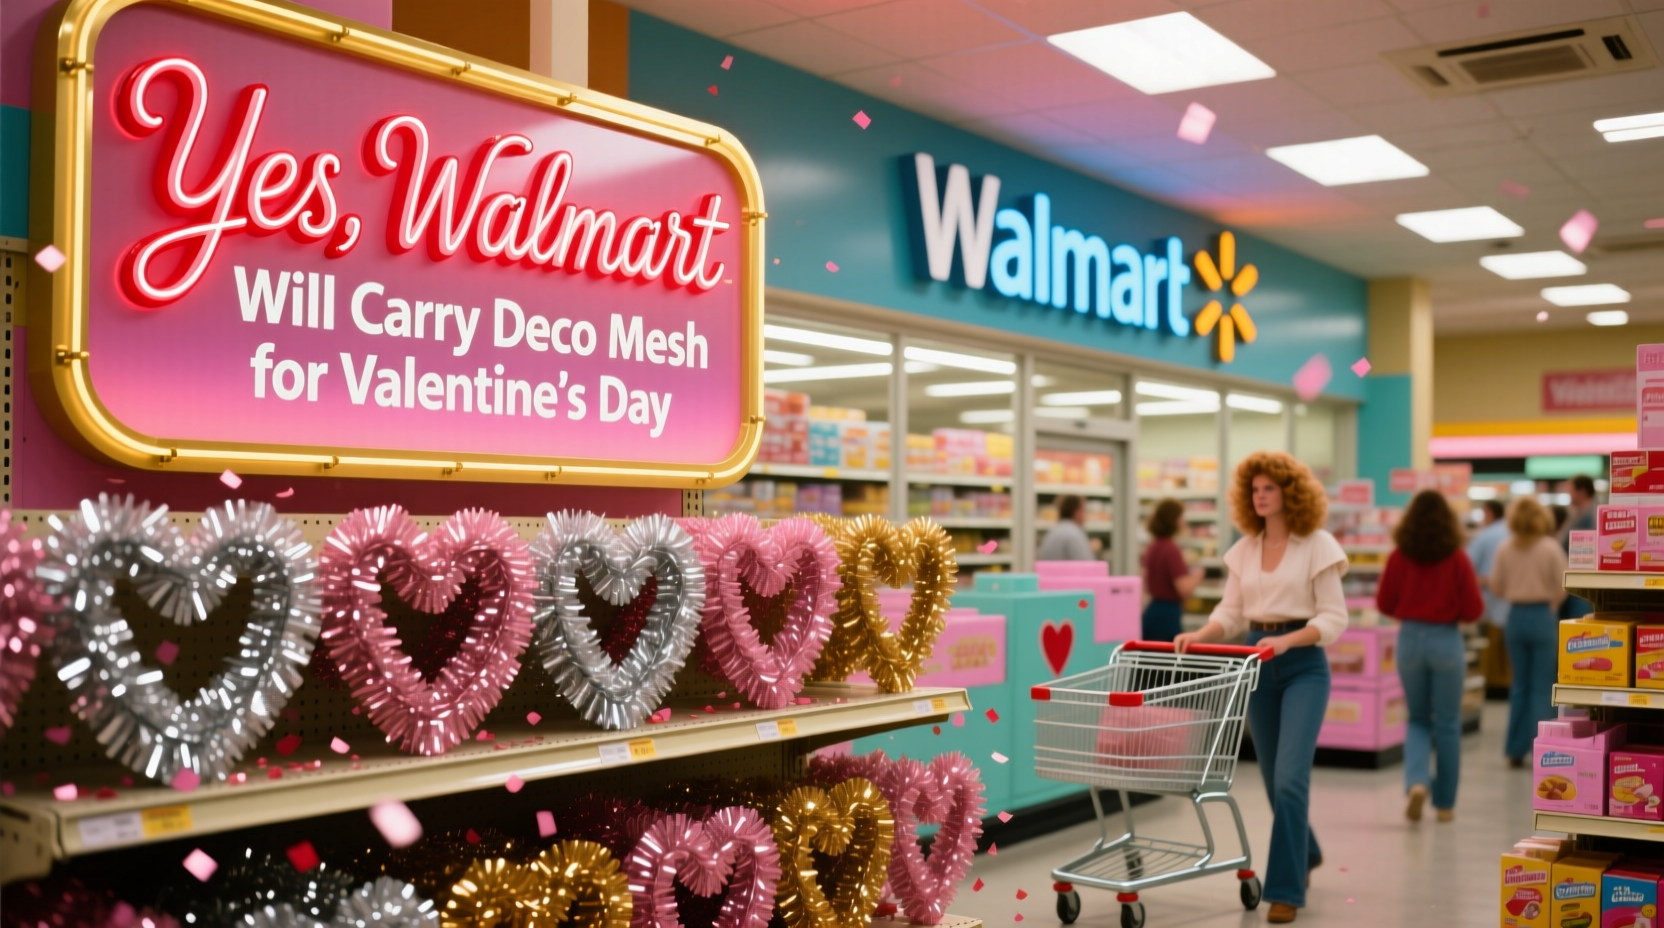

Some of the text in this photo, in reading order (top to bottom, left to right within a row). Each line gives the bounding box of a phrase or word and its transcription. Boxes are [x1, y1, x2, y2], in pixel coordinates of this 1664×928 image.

[118, 57, 730, 306] Yes, Walmart
[912, 152, 1191, 338] Walmart
[233, 266, 709, 369] Will Carry Deco Mesh
[250, 343, 672, 438] for Valentine’s Day
